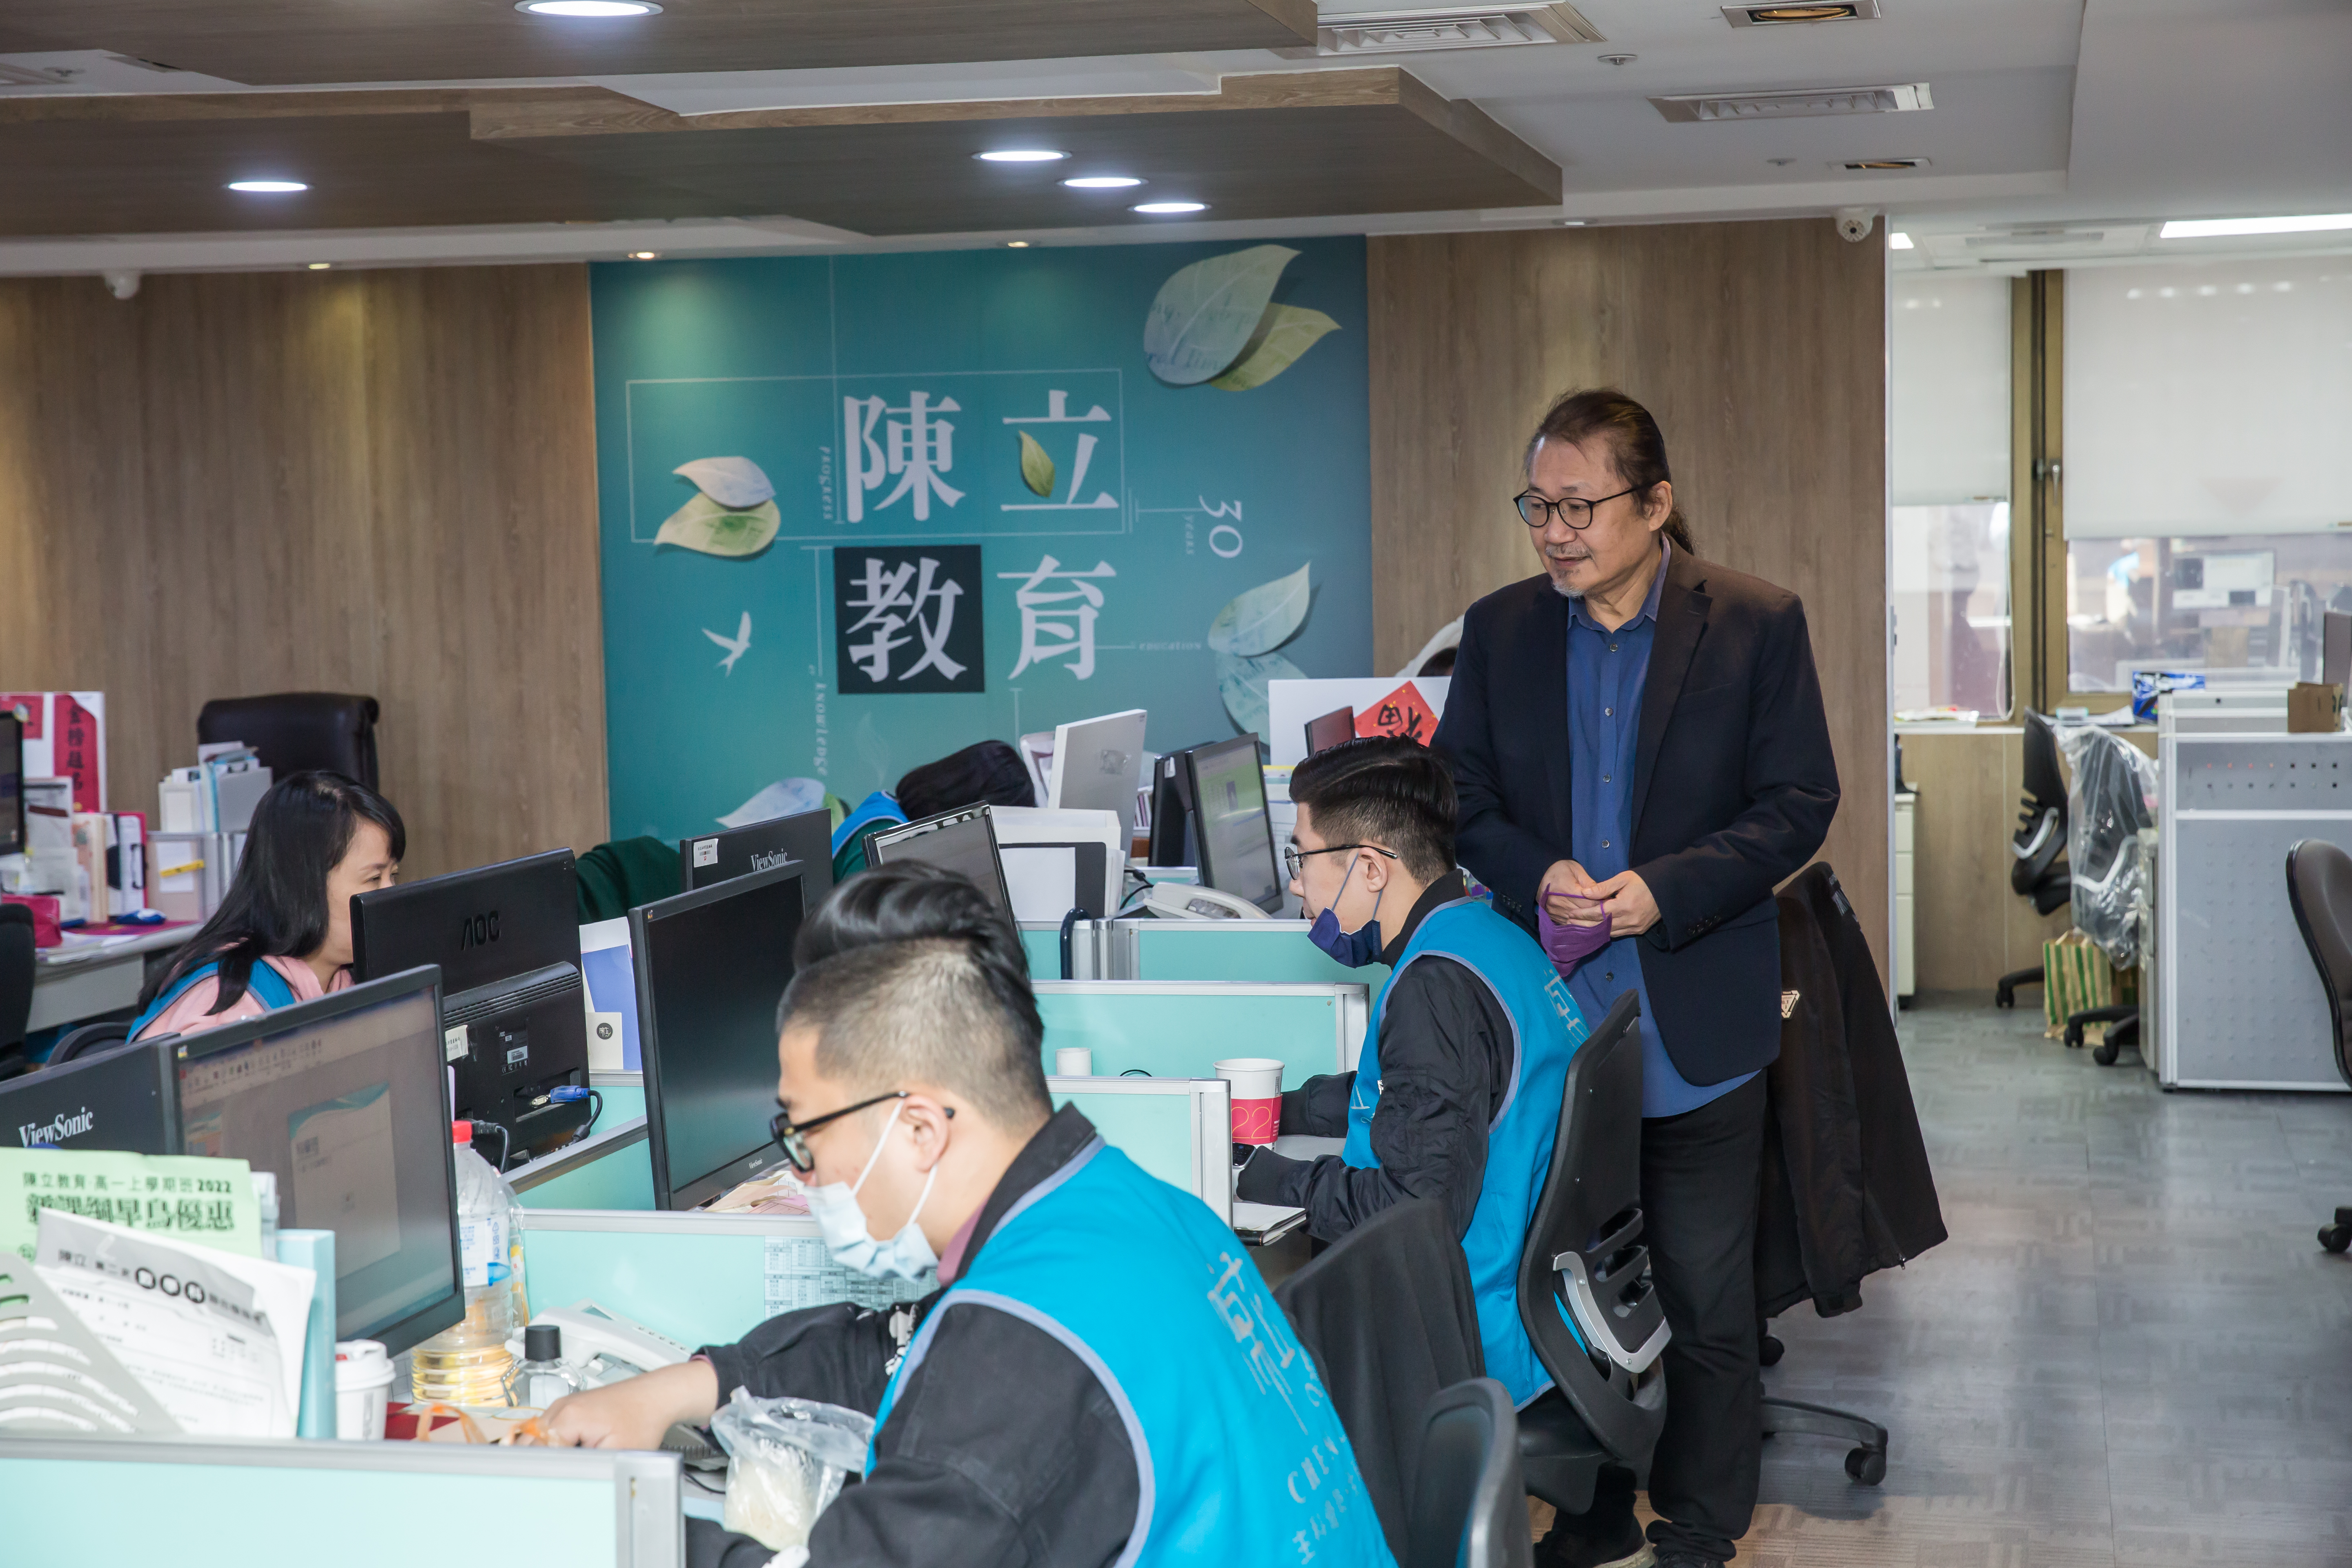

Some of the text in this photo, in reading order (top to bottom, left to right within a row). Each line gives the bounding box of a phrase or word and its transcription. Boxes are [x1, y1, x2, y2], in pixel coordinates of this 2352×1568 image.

[844, 390, 1119, 523] 陳立
[1198, 494, 1243, 559] 30
[846, 554, 1117, 682] 教育
[751, 848, 787, 871] ViewSonic
[460, 910, 501, 951] AOC
[19, 1106, 94, 1148] ViewSonic
[197, 1179, 231, 1193] 2022
